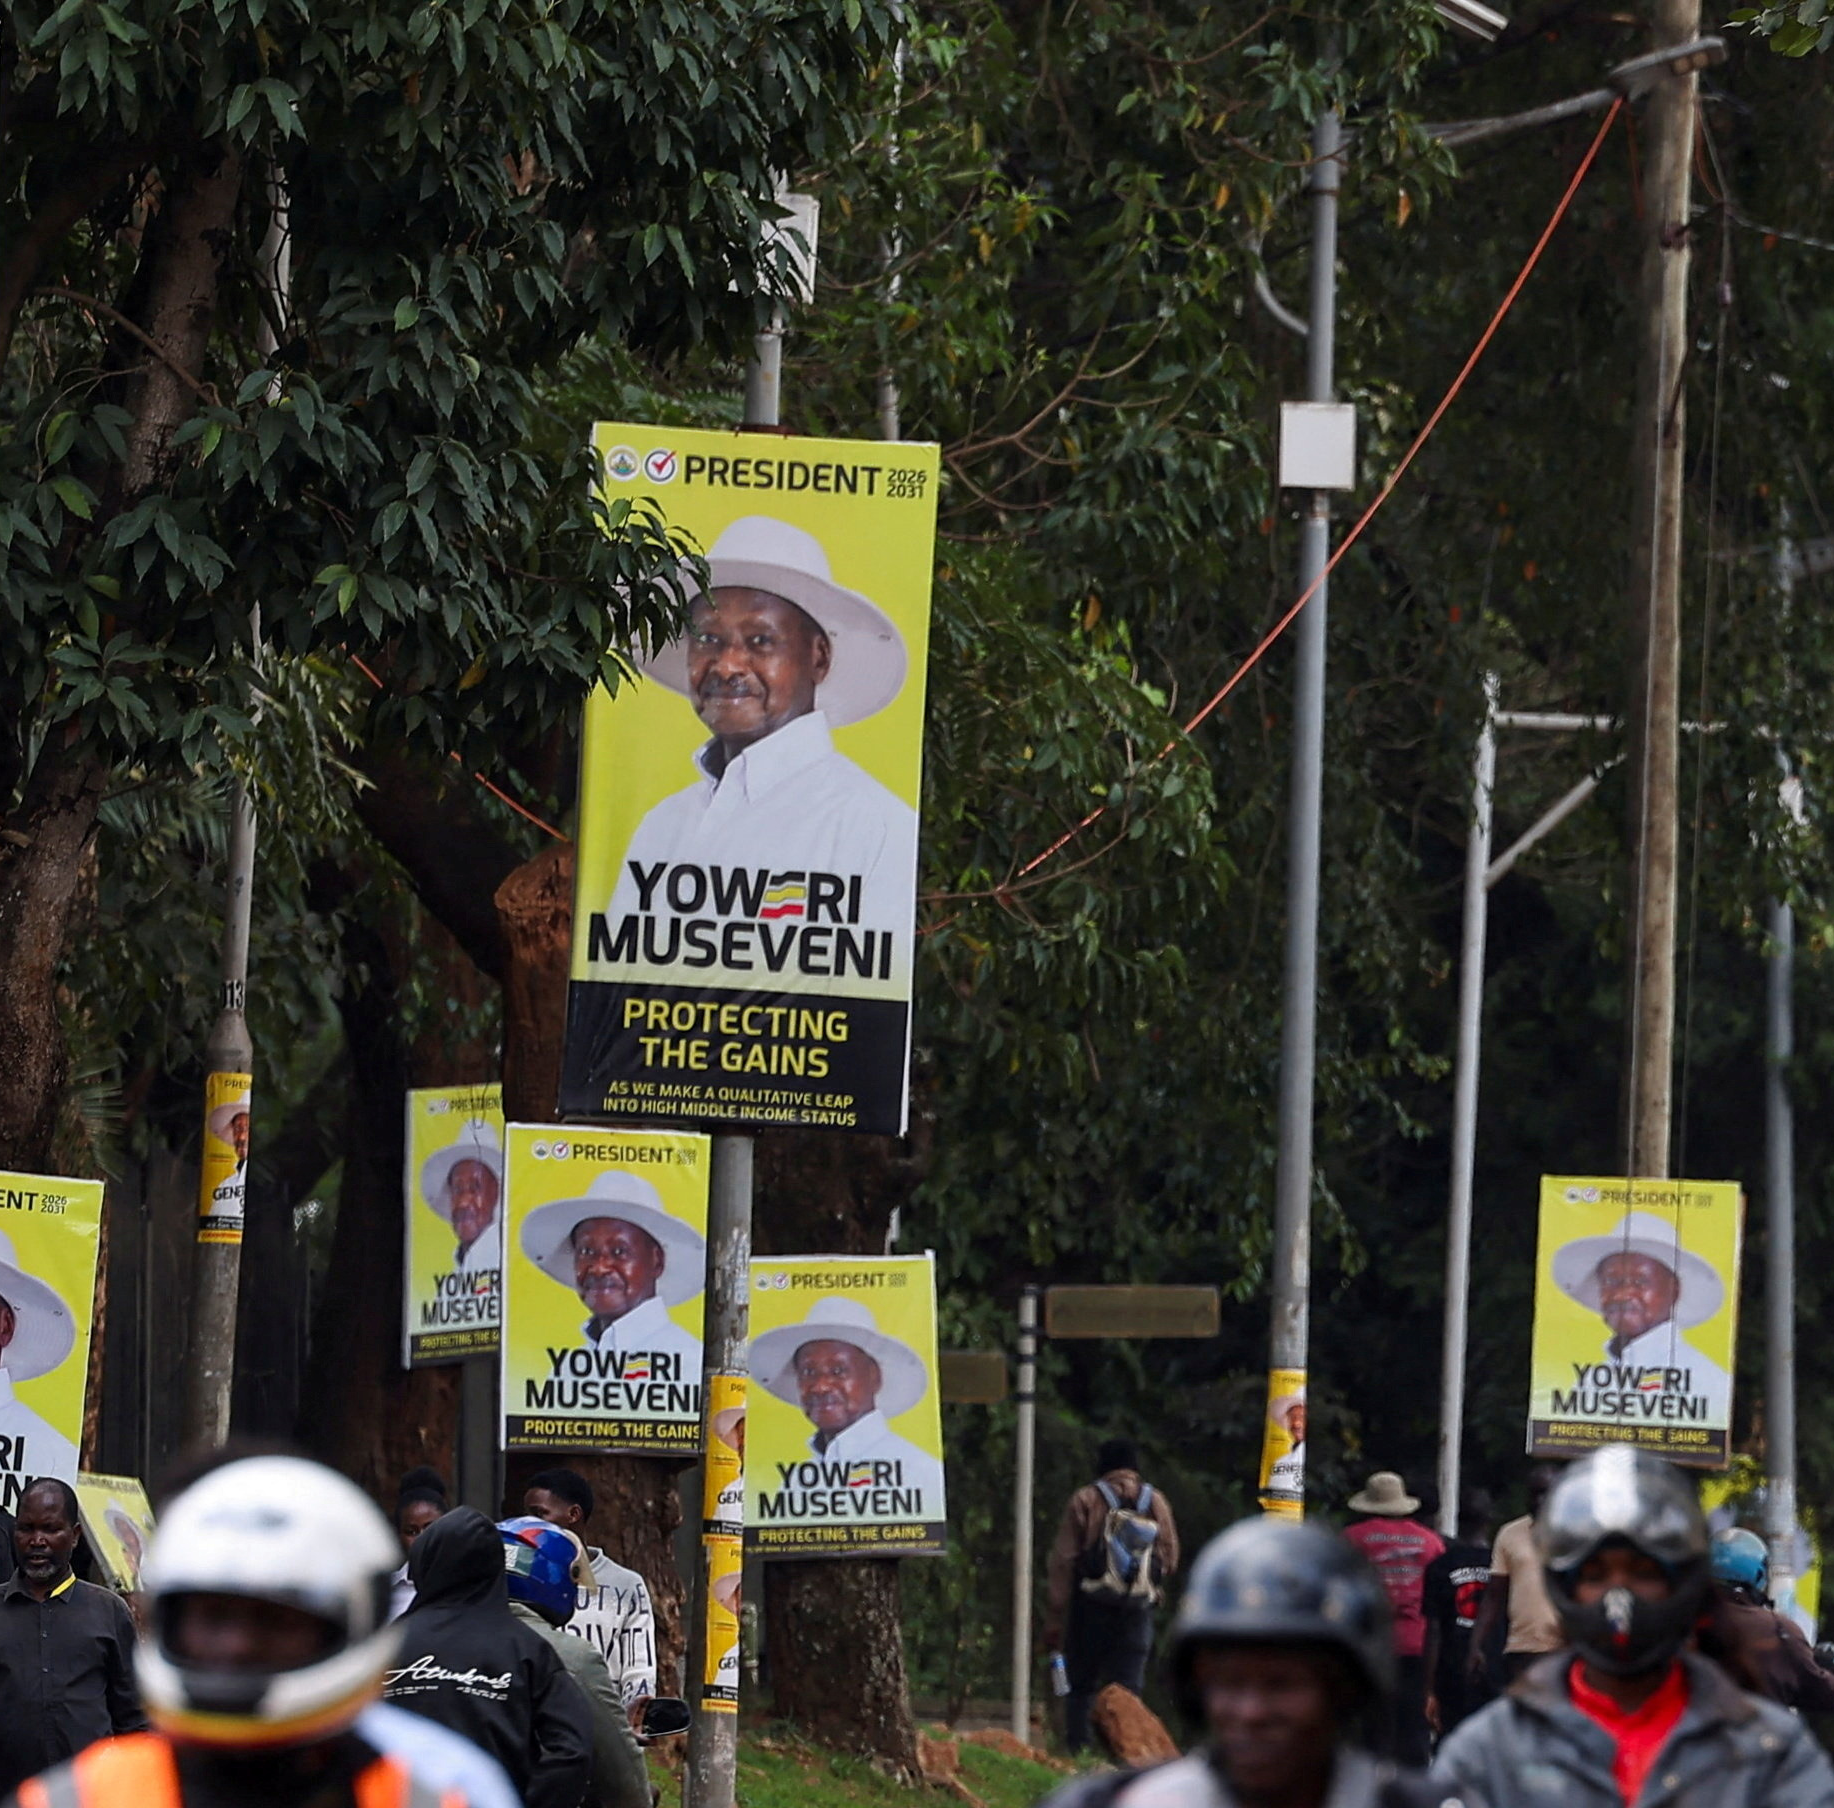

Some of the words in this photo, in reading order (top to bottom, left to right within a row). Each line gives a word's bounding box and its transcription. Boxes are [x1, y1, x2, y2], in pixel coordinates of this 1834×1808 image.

[684, 455, 882, 495] PRESIDENT
[887, 468, 927, 484] 2026
[886, 483, 924, 499] 2031
[627, 860, 862, 924] YOWERI
[587, 913, 892, 980] MUSEVENI
[623, 999, 848, 1042] PROTECTING
[639, 1037, 709, 1070] THE
[721, 1042, 829, 1078] GAINS
[609, 1081, 628, 1095] AS
[632, 1082, 655, 1096] WE
[660, 1083, 701, 1099] MAKE
[705, 1086, 714, 1099] A
[718, 1087, 811, 1106] QUALITATIVE
[816, 1094, 854, 1109] LEAP
[603, 1097, 637, 1112] INTO
[641, 1099, 677, 1114] HIGH
[681, 1101, 736, 1118] MIDDLE
[740, 1104, 797, 1122] INCOME
[801, 1108, 856, 1126] STATUS
[573, 1144, 673, 1163] PRESIDENT
[40, 1204, 65, 1215] 2031
[42, 1194, 68, 1206] 2026
[791, 1272, 884, 1289] PRESIDENT
[547, 1347, 681, 1381] YOWERI
[1573, 1363, 1690, 1392] YOWERI
[1552, 1390, 1708, 1420] MUSEVENI
[524, 1419, 620, 1437] PROTECTING
[623, 1423, 653, 1437] THE
[1549, 1423, 1635, 1441] PROTECTING
[1637, 1427, 1663, 1442] THE
[776, 1460, 902, 1489] YOWERI
[758, 1488, 921, 1519] MUSEVENI
[759, 1529, 847, 1543] PROTECTING
[852, 1527, 878, 1541] THE
[882, 1525, 926, 1540] GAINS
